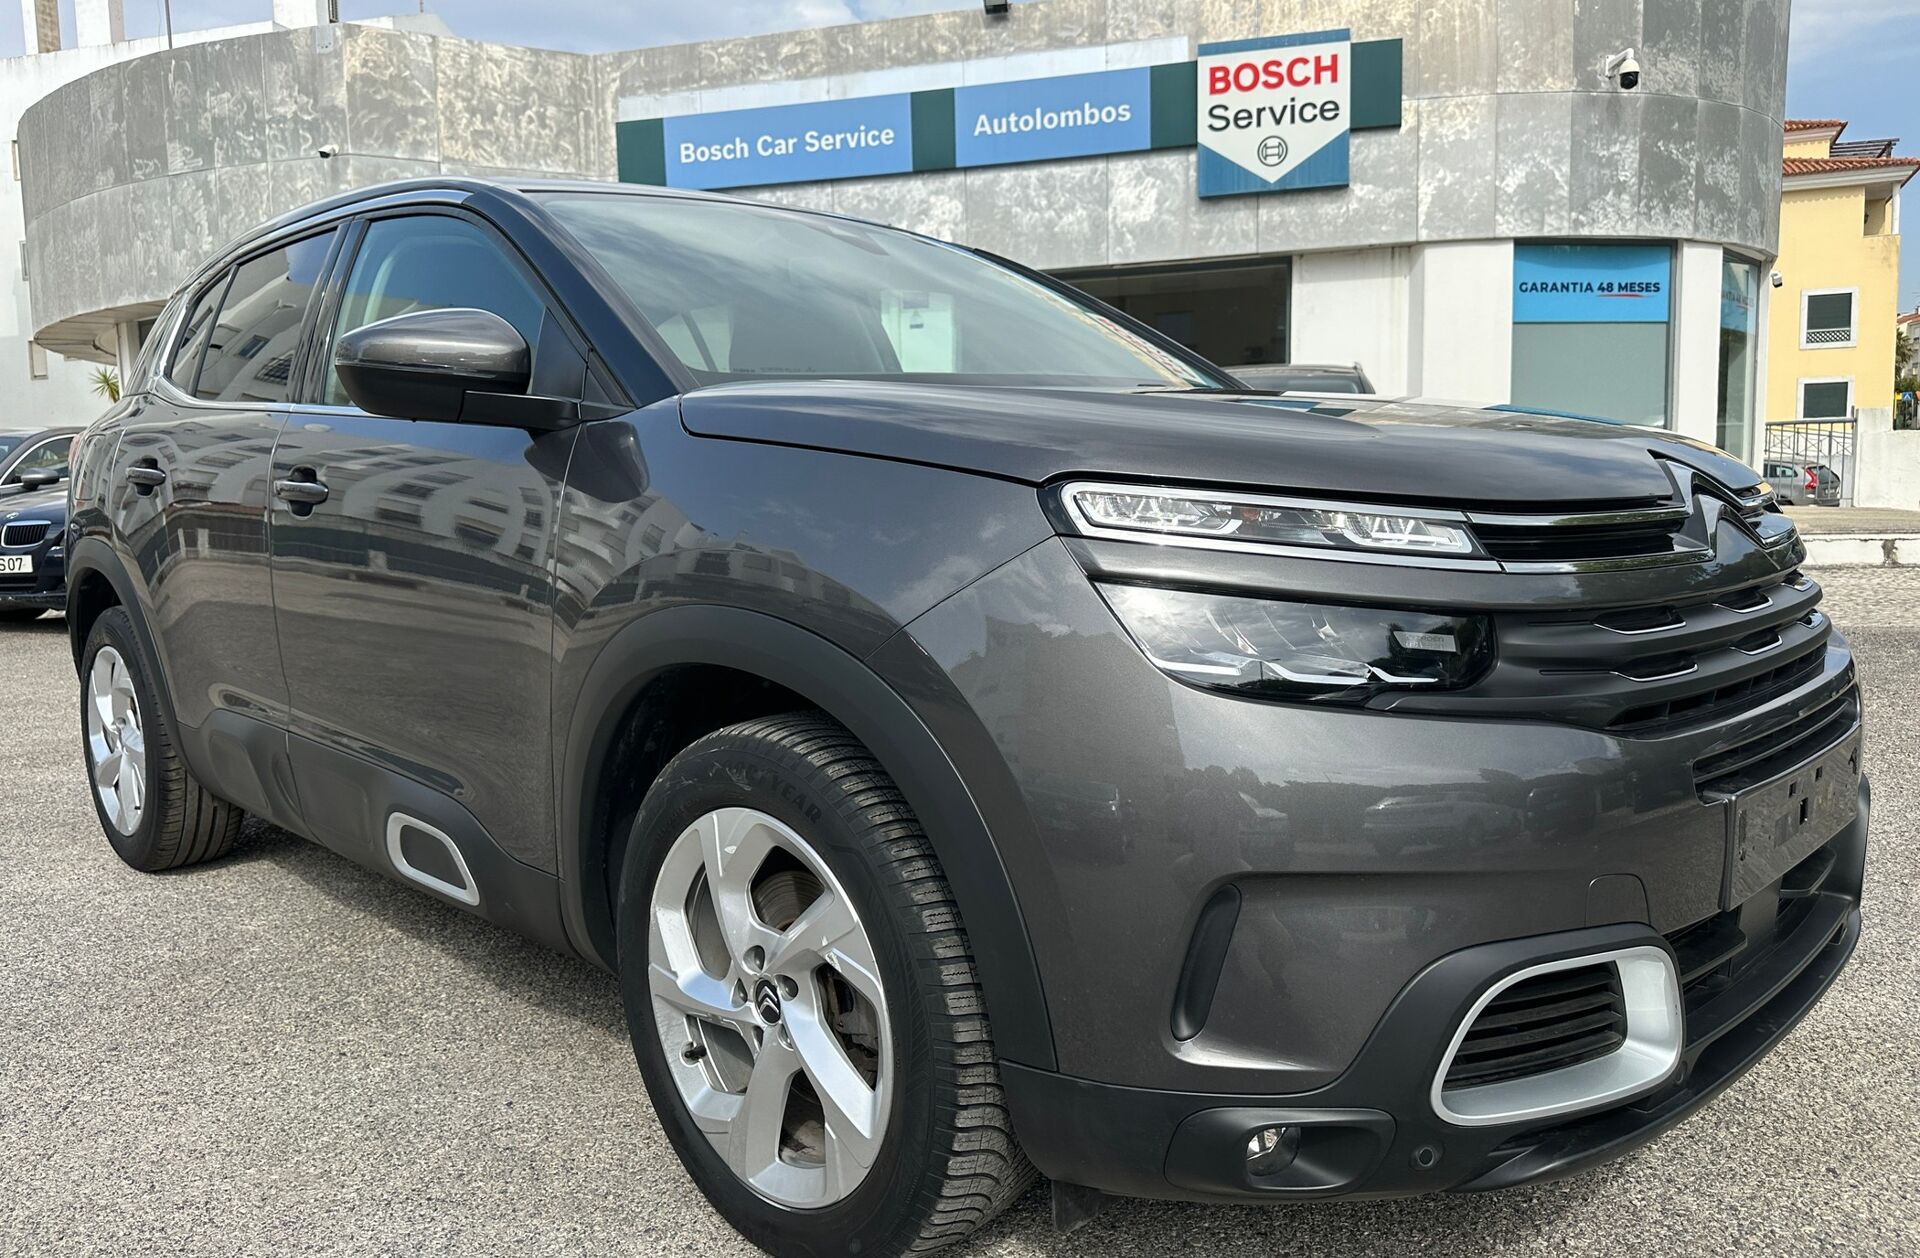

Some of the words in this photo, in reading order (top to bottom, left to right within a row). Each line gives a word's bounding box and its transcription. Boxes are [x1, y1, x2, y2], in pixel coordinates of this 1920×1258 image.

[1209, 54, 1338, 95] BOSCH
[973, 102, 1131, 137] Autolombos
[1208, 97, 1340, 132] Service
[680, 137, 749, 163] Bosch
[756, 135, 798, 156] Car
[804, 125, 894, 152] Service
[1519, 282, 1594, 293] GARANTIA
[1597, 282, 1614, 292] 48
[1618, 282, 1661, 293] MESES
